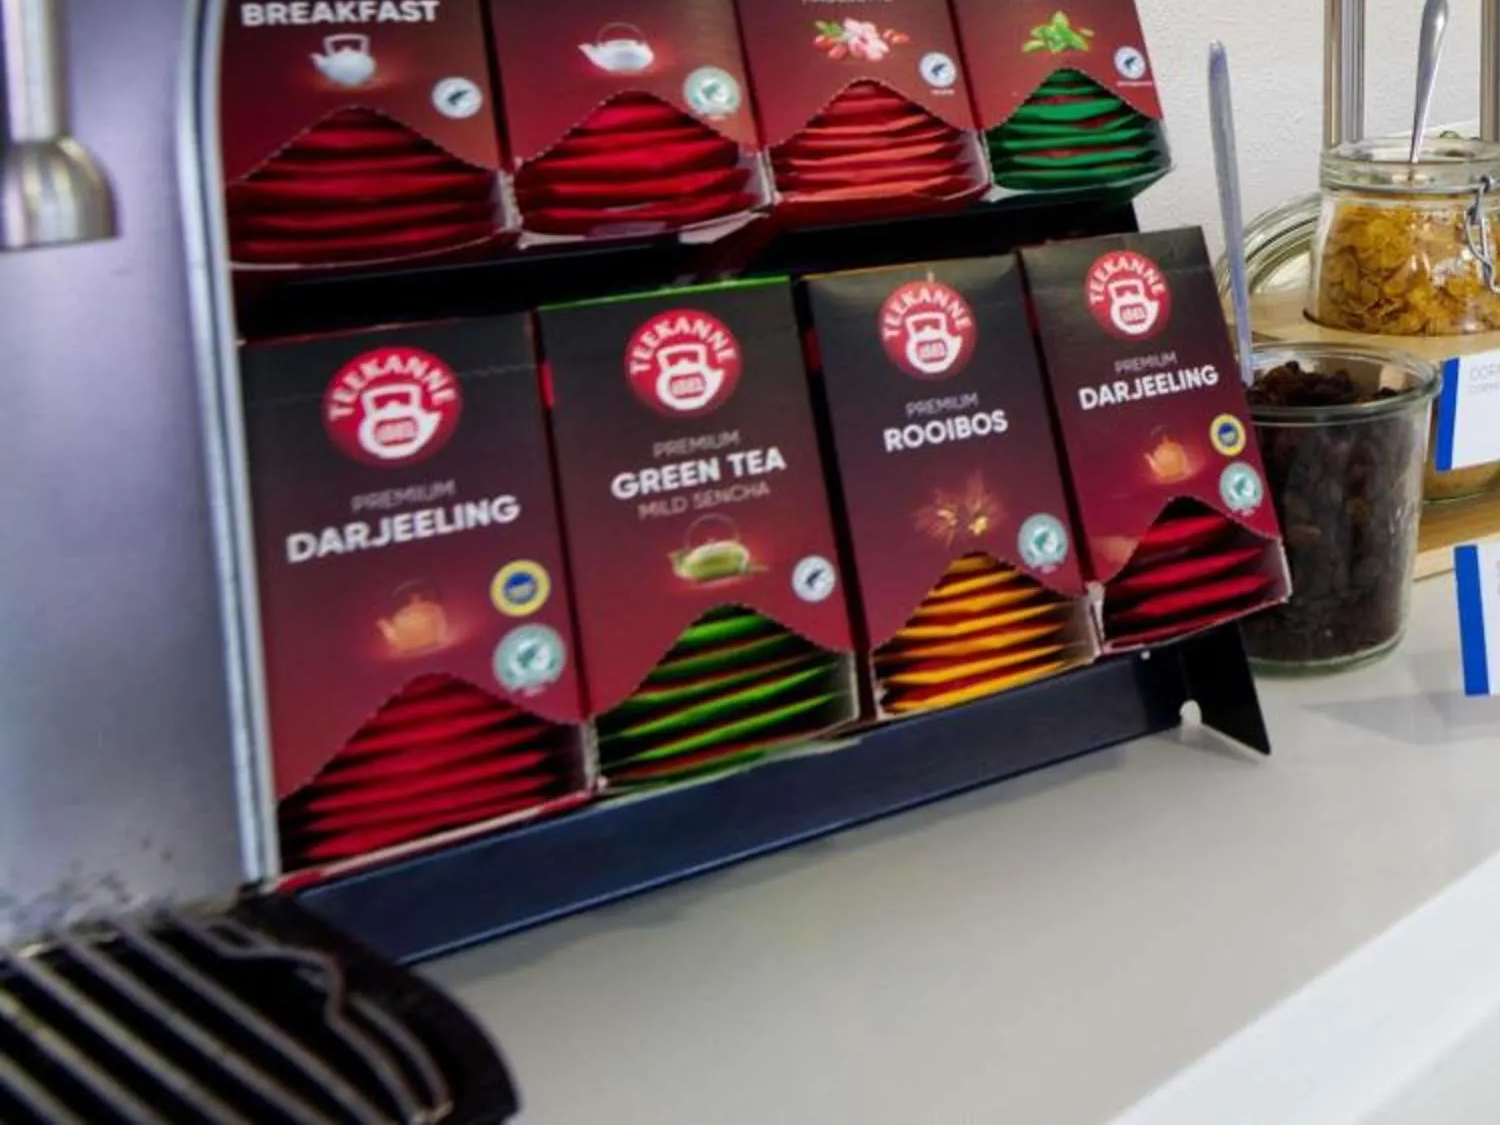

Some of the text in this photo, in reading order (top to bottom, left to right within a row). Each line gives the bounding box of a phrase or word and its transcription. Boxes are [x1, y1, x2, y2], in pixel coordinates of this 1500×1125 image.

[241, 0, 440, 27] BREAKFAST
[1088, 256, 1167, 305] TEEKANNE
[881, 286, 972, 341] TEEKANNE
[629, 316, 737, 375] TEEKANNE
[1113, 351, 1178, 375] PREMIUM
[328, 354, 458, 422] TEEKANNE
[904, 392, 979, 418] PREMIUM
[1078, 364, 1219, 411] DARJEELING
[653, 430, 740, 457] PREMIUM
[883, 409, 1009, 453] ROOIBOS
[350, 479, 456, 512] PREMIUM
[610, 446, 787, 500] GREEN TEA
[637, 481, 771, 520] MILD SENCHA
[286, 494, 521, 563] DARJEELING
